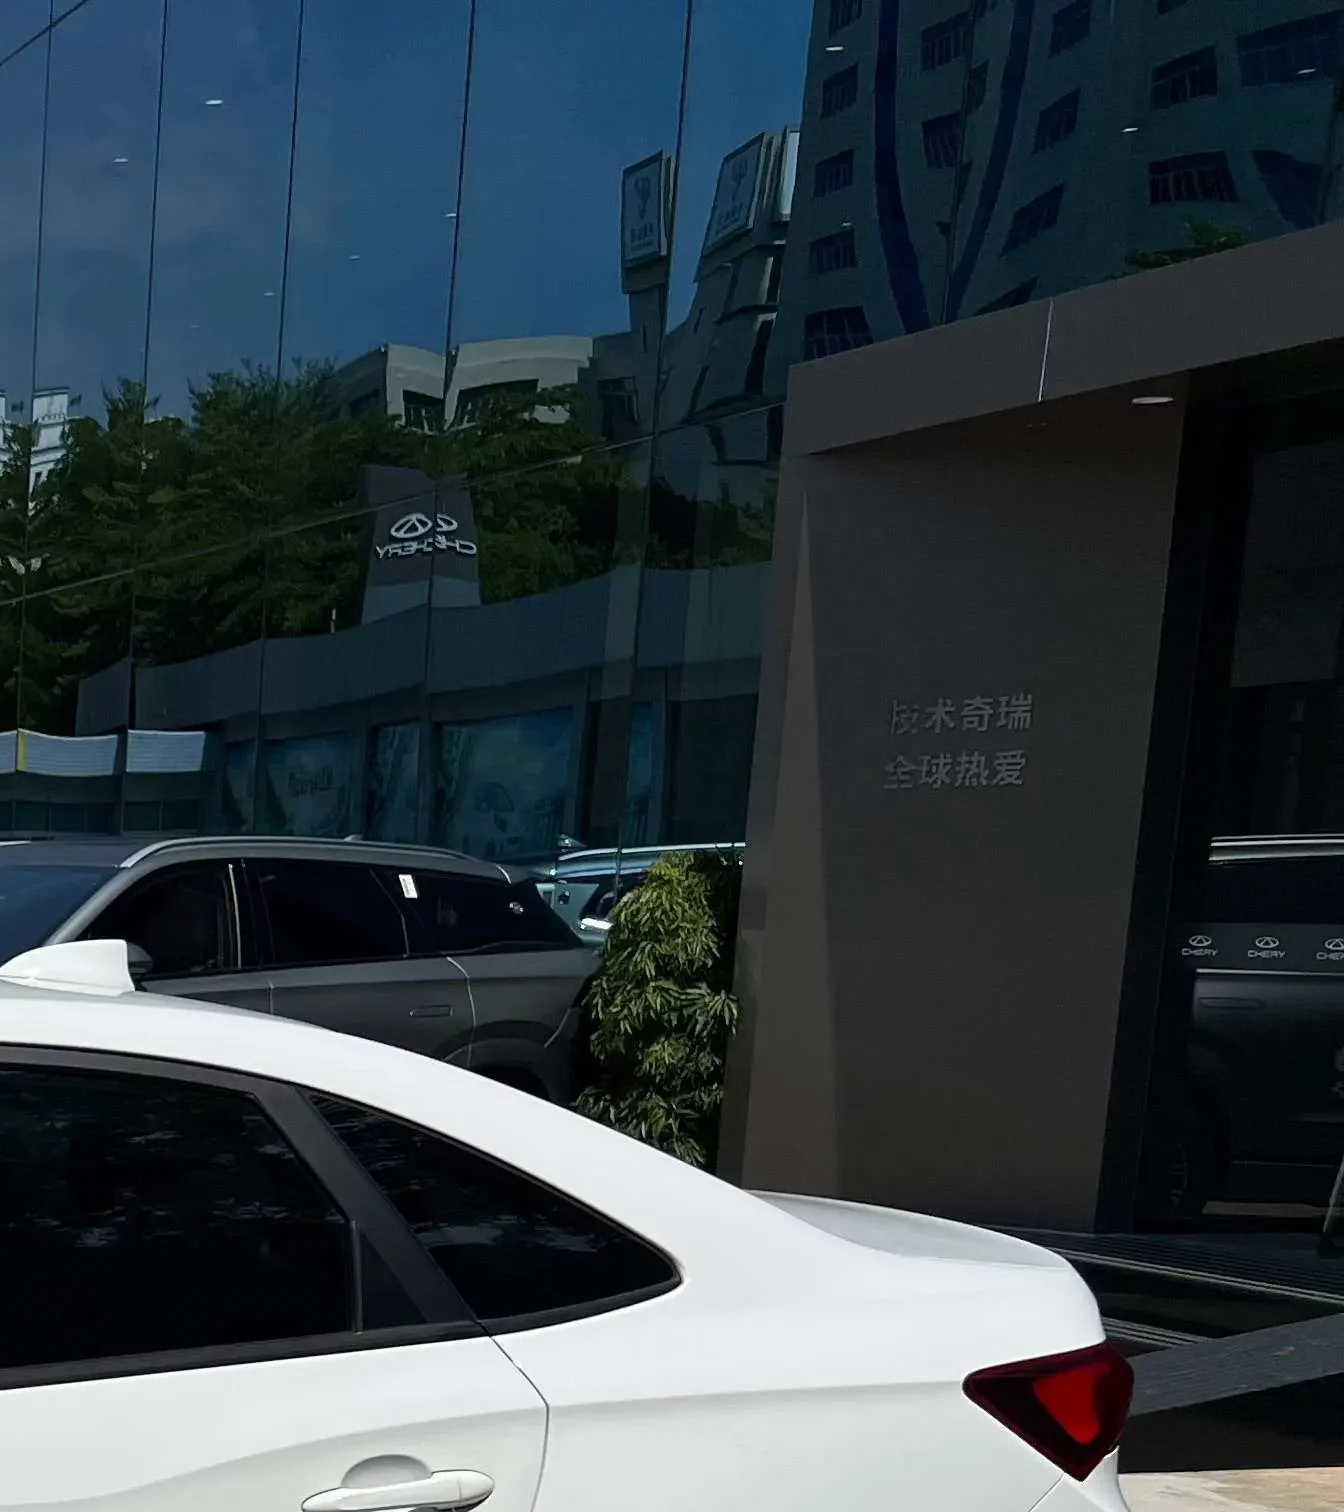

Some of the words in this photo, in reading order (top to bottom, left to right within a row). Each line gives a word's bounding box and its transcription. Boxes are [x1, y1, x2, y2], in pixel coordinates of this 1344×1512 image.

[883, 750, 1028, 789] 全球热爱
[1247, 950, 1286, 959] CHERY
